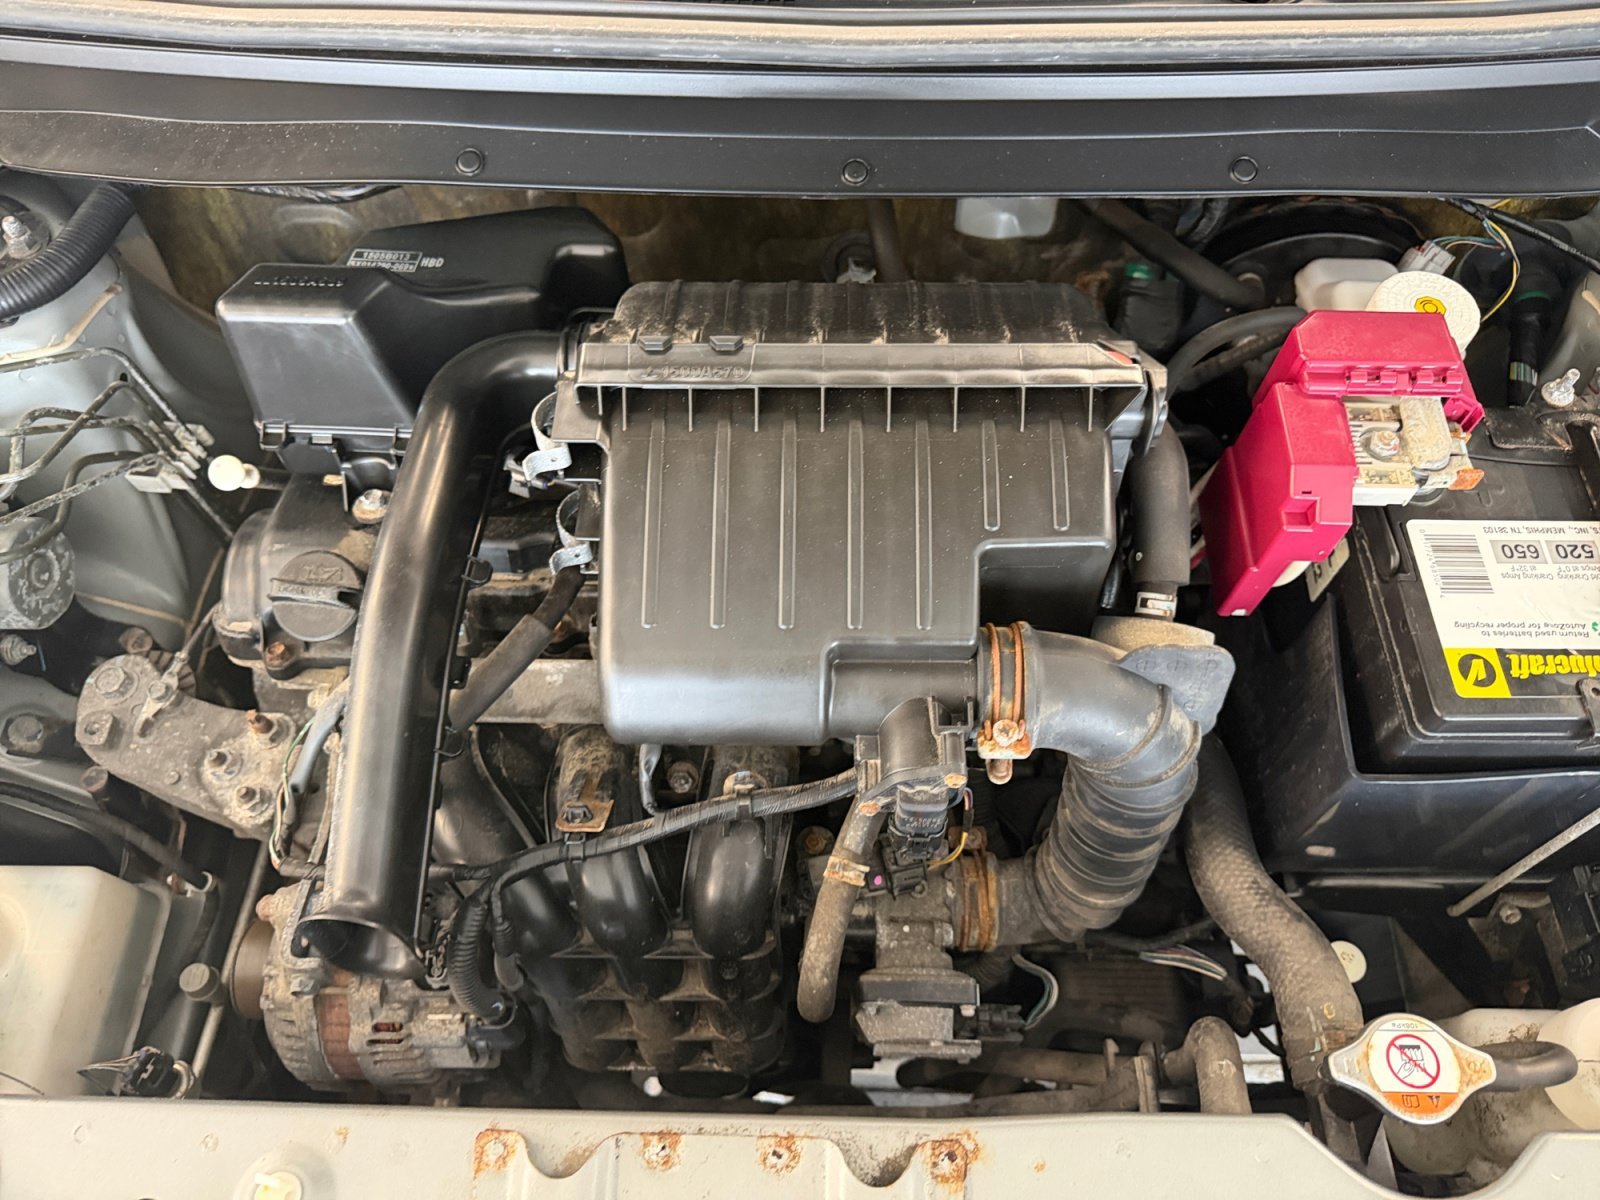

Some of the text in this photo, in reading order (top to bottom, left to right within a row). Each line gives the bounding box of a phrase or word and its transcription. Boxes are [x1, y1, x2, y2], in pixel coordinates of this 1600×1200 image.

[1501, 544, 1540, 559] 650
[1555, 544, 1594, 559] 520
[1501, 572, 1554, 580] Cranking Amps
[1557, 572, 1589, 580] Cranking
[1454, 621, 1494, 629] recycling
[1496, 621, 1525, 629] proper
[1535, 630, 1556, 638] used
